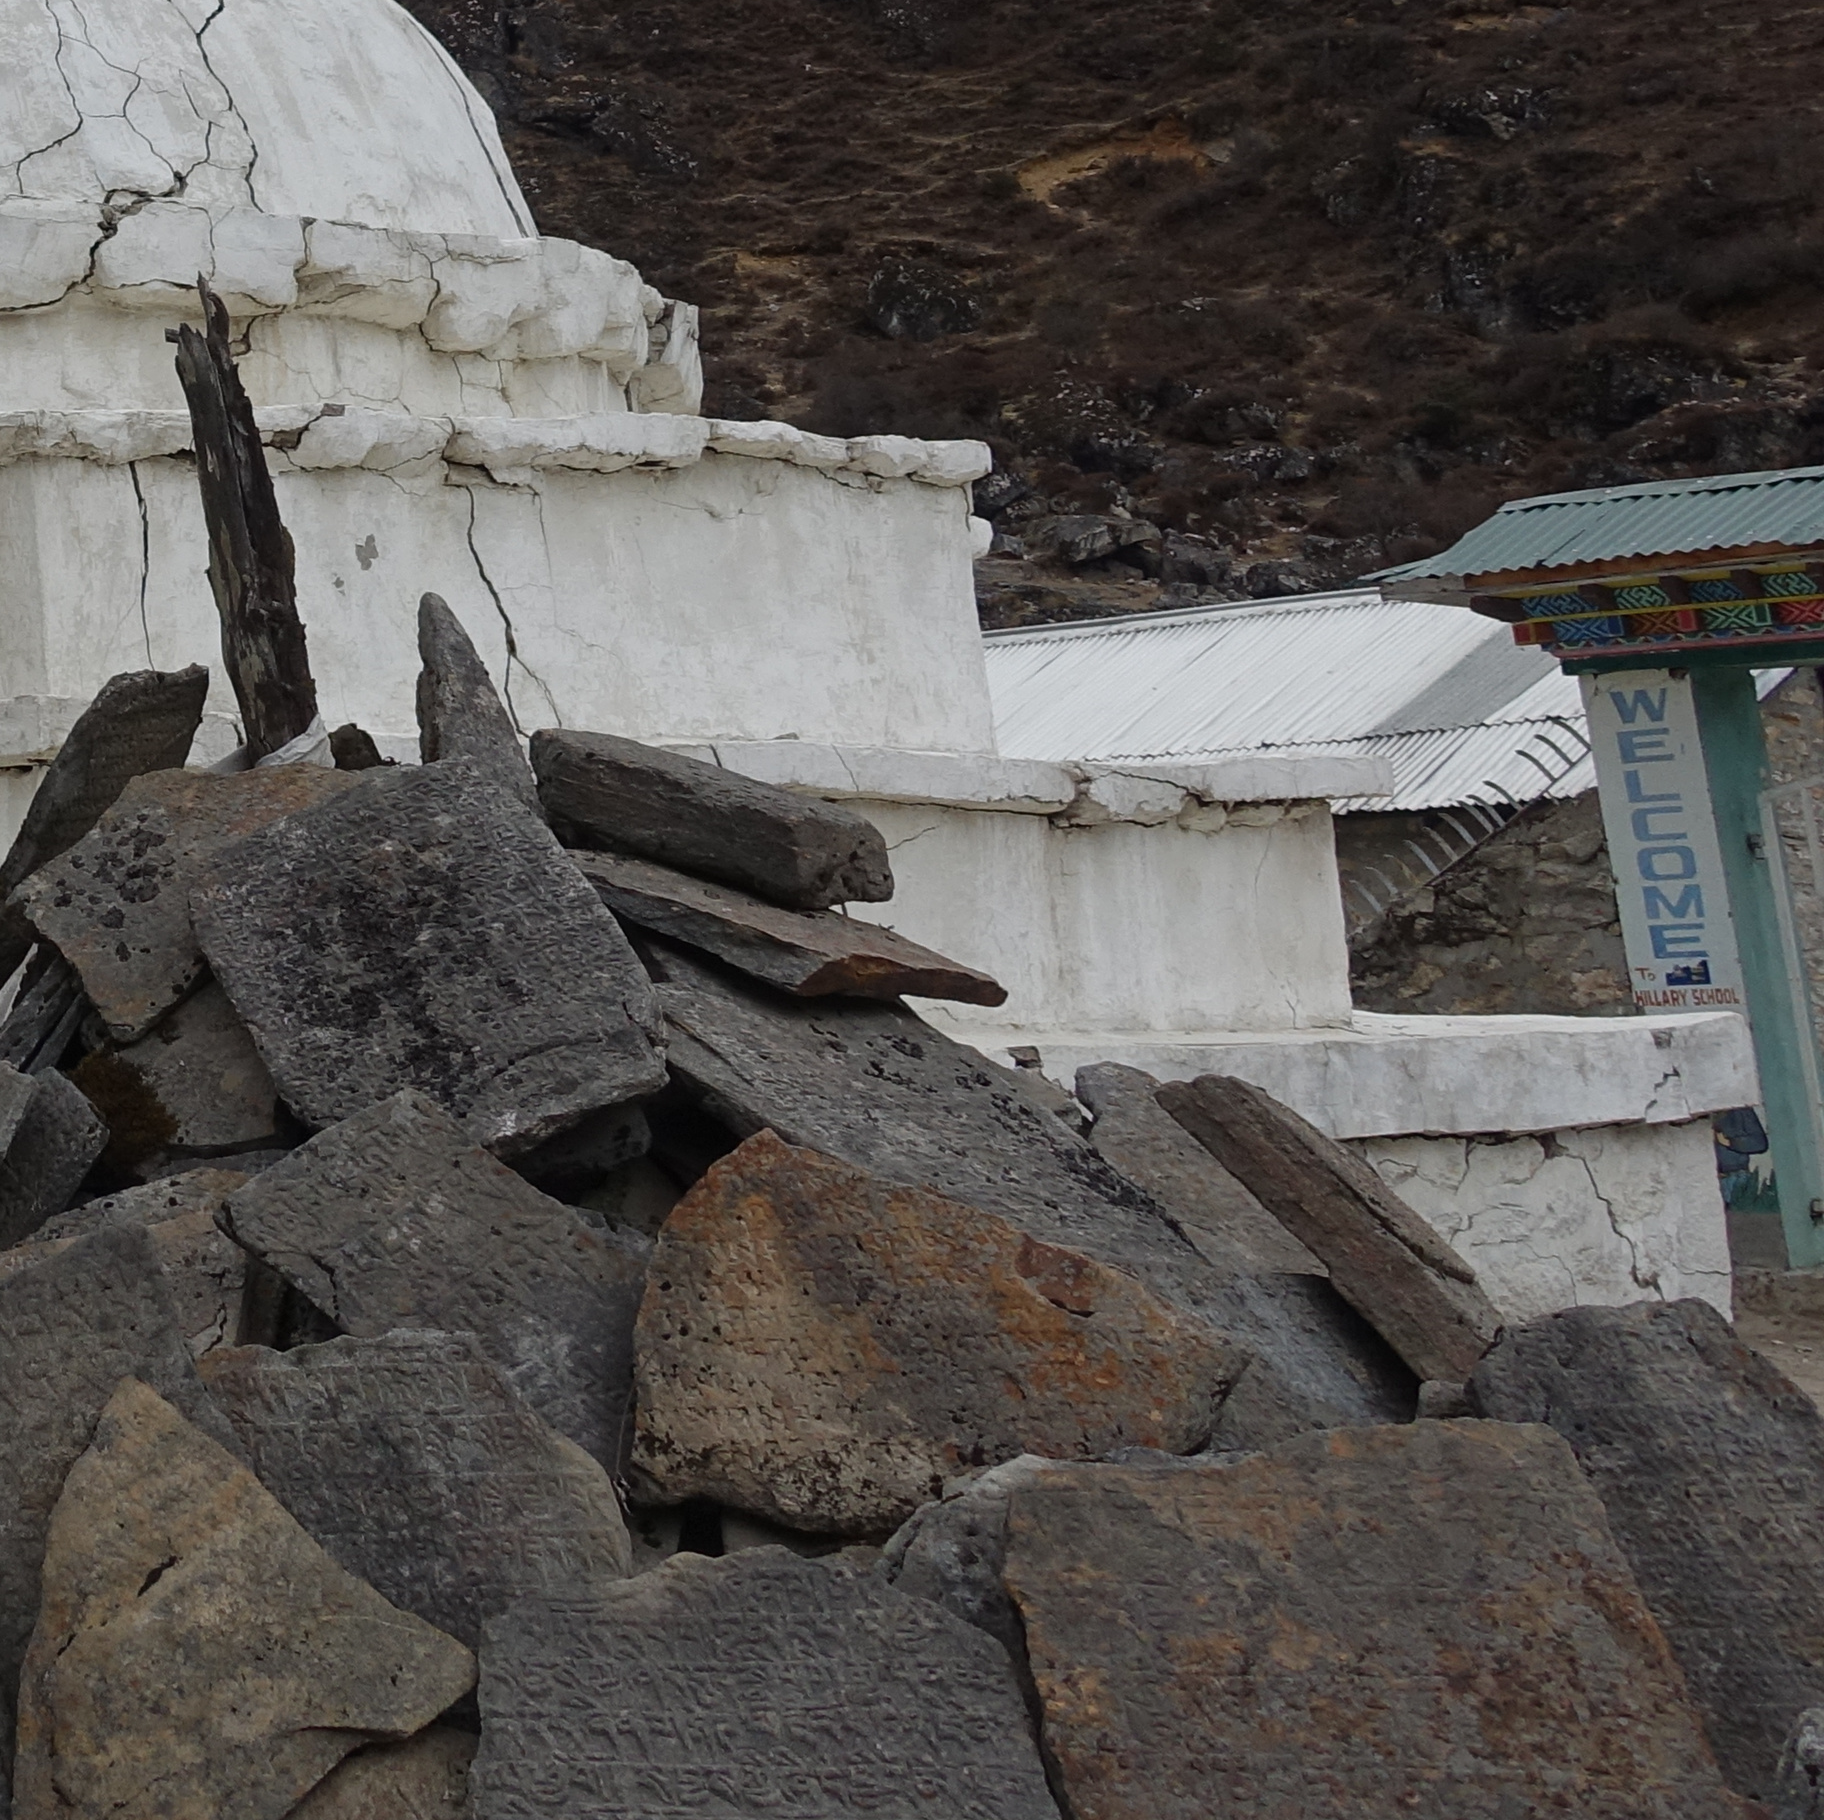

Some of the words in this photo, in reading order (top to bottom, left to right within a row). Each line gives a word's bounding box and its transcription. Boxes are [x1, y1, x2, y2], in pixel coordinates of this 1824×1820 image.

[1610, 688, 1710, 960] WELCOME
[1634, 988, 1687, 1006] HILLARY
[1692, 987, 1740, 1005] SCHOOL
